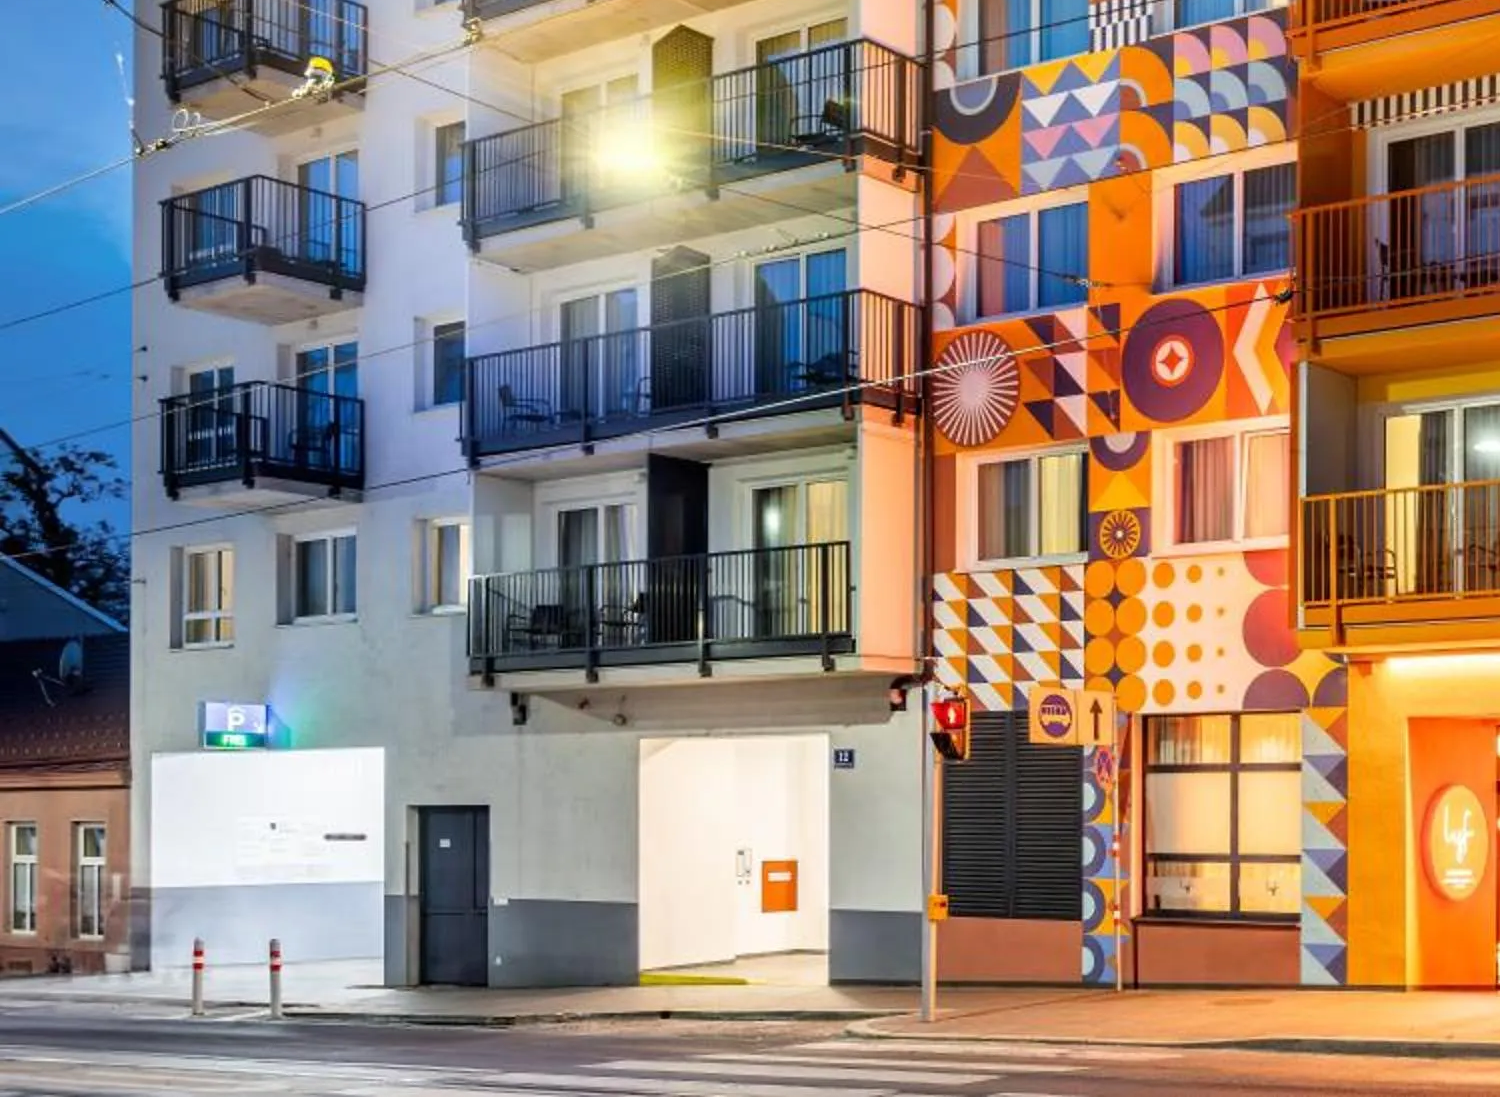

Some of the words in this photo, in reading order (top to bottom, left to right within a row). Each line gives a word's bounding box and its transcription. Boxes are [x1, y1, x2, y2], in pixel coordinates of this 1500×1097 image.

[227, 706, 246, 731] P
[839, 751, 849, 762] 12
[1443, 803, 1475, 864] lyf
